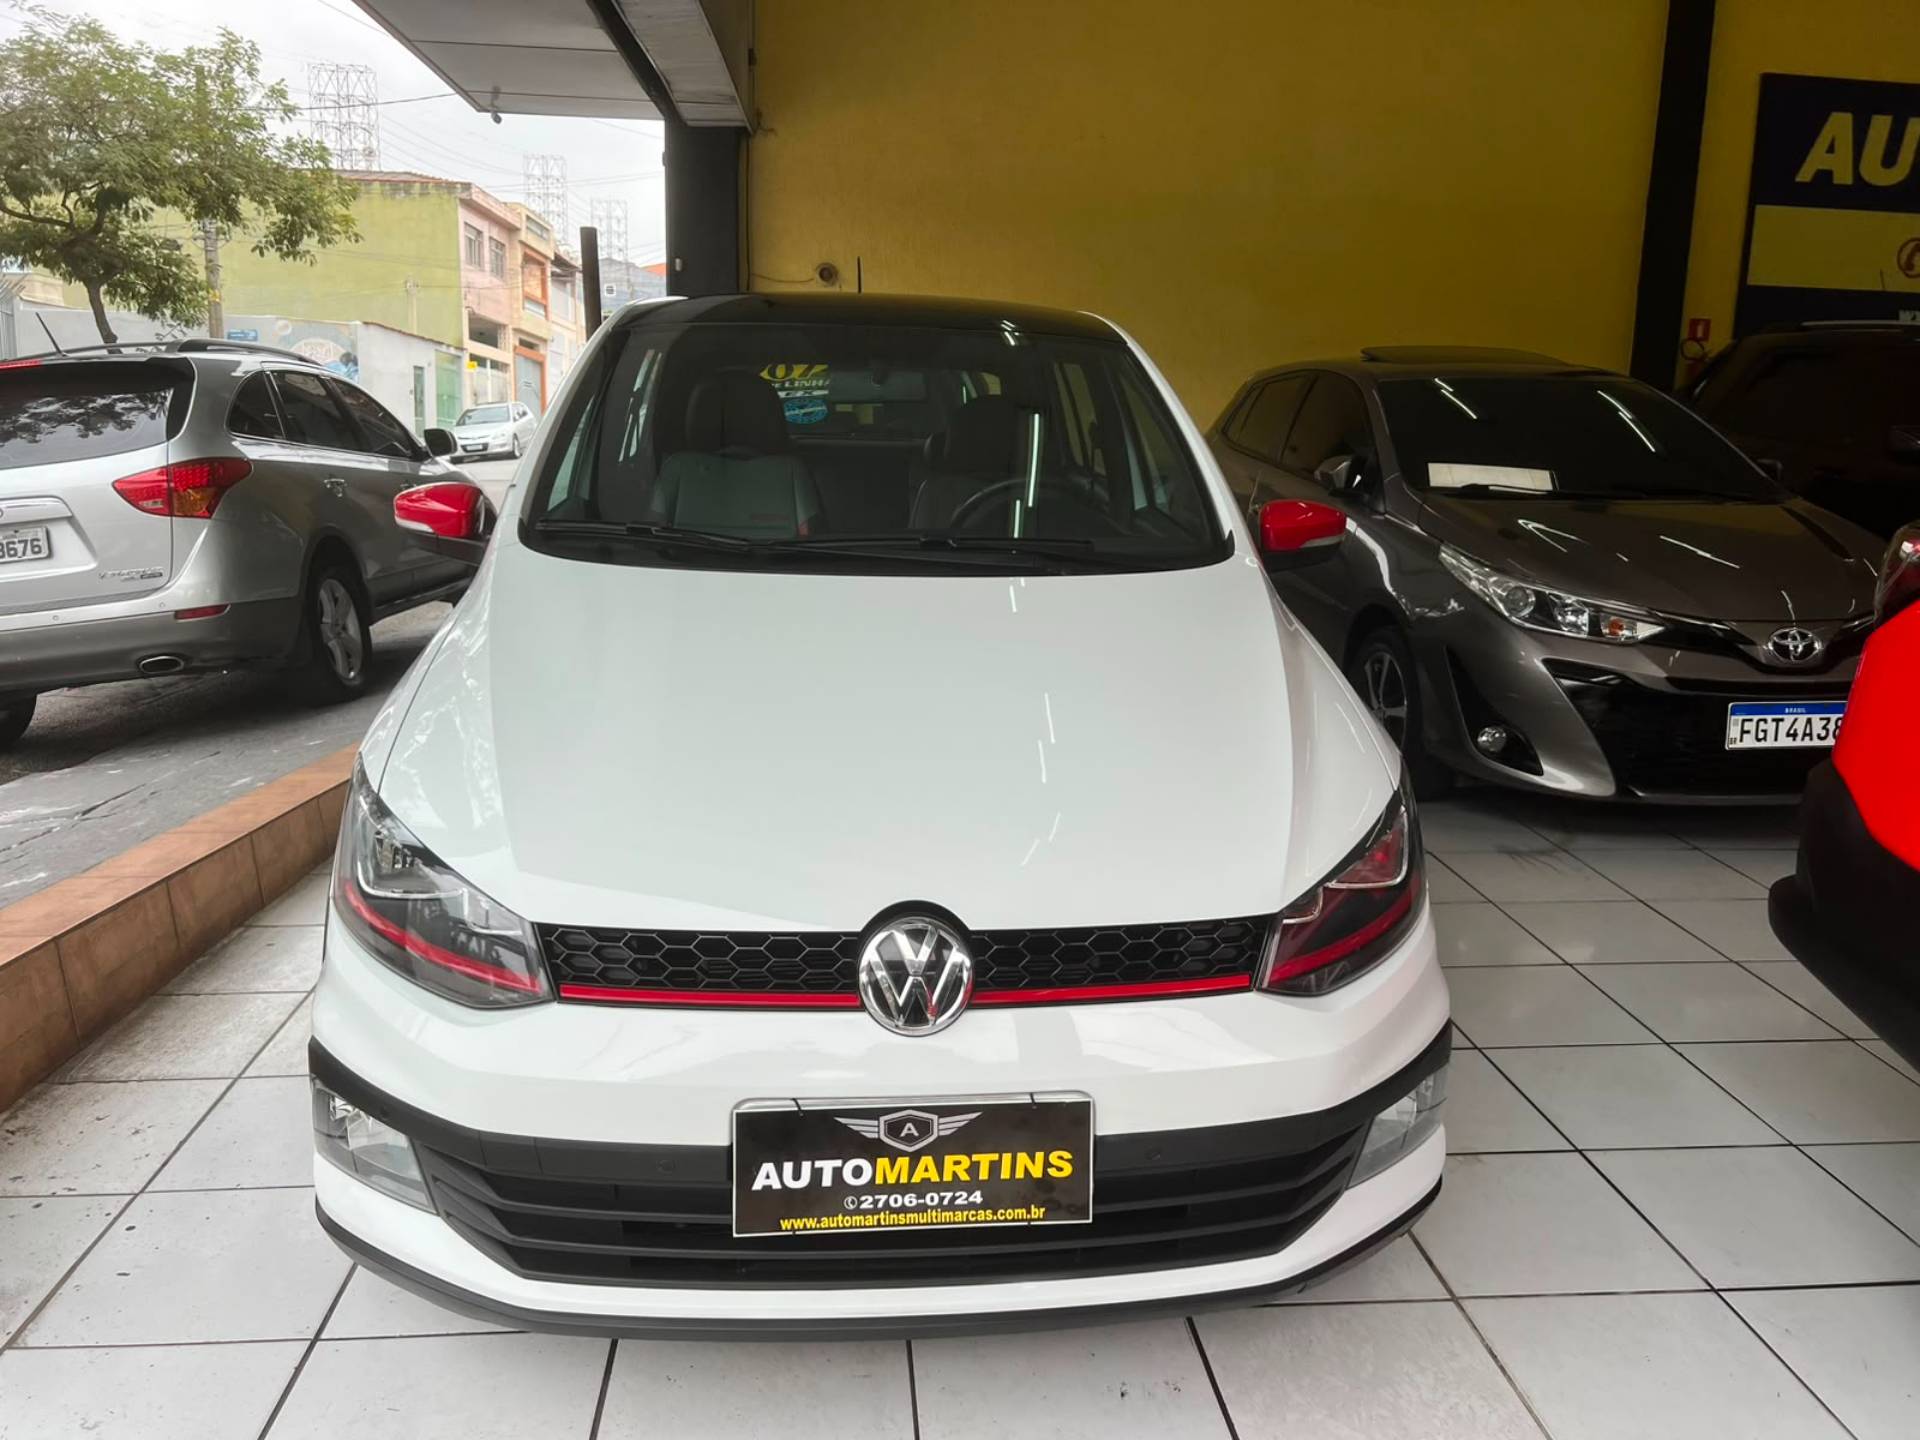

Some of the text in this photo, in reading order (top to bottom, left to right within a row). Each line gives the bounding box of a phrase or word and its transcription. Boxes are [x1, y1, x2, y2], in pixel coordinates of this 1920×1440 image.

[900, 1122, 919, 1137] A
[751, 1150, 1074, 1191] AUTOMARTINS
[859, 1190, 983, 1209] 2706-0724
[780, 1204, 1046, 1231] www.automartinsmultimarcas.com.br
